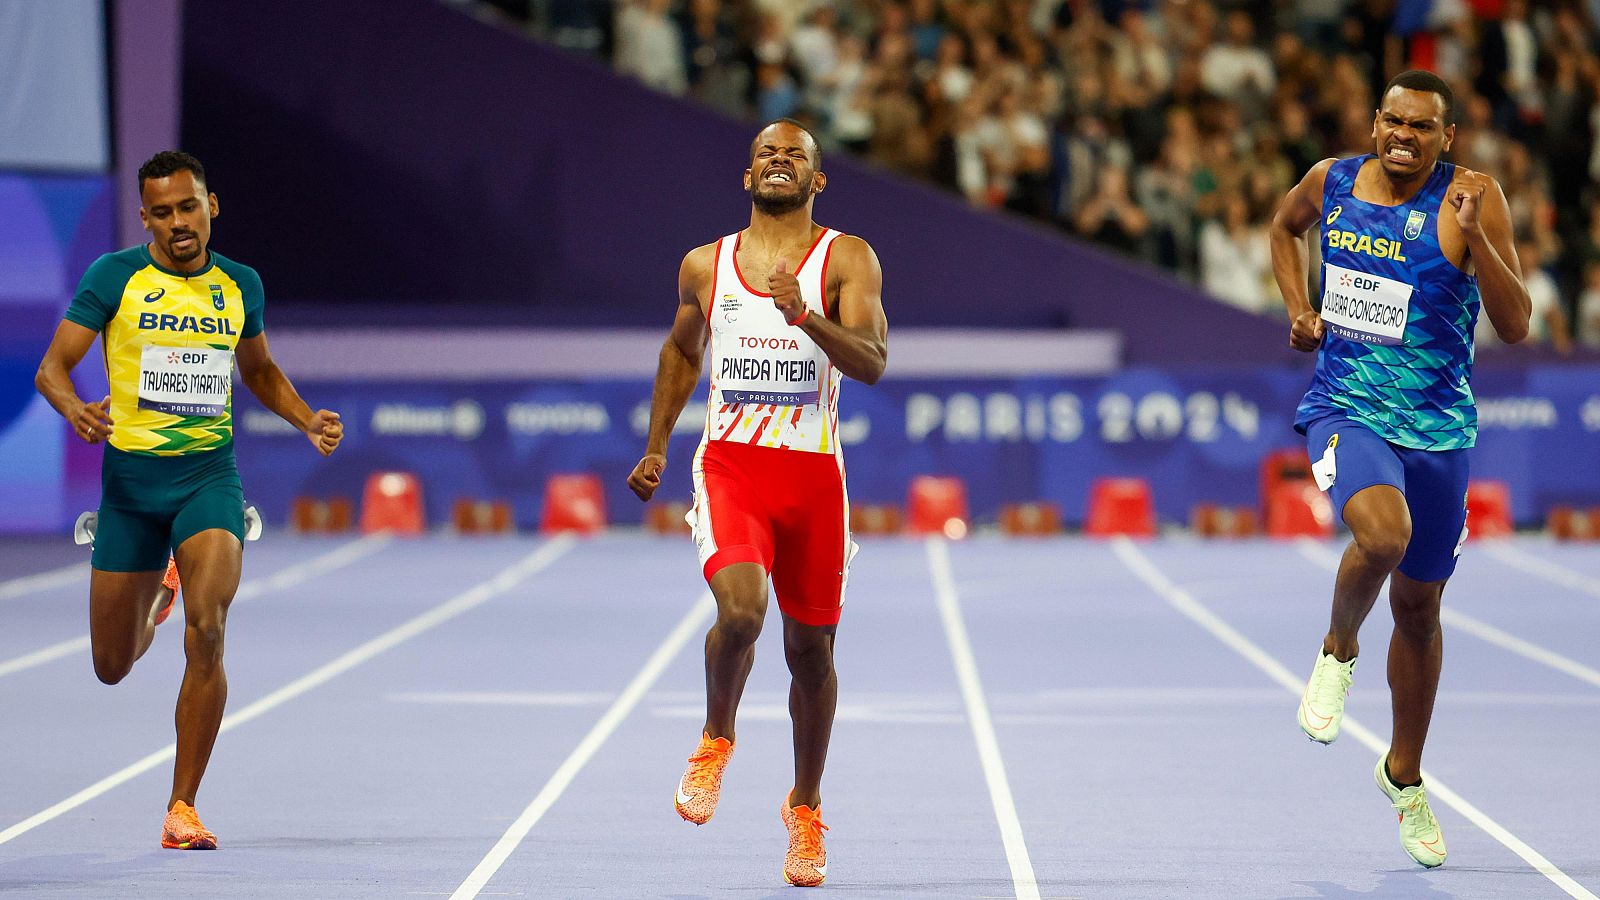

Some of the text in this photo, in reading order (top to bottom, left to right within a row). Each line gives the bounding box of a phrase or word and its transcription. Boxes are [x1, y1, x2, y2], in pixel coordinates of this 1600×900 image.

[1327, 229, 1406, 262] BRASIL
[1353, 277, 1381, 292] eDF
[1348, 297, 1404, 328] CONCEICAO
[138, 312, 236, 336] BRASIL
[738, 336, 799, 351] TOYOTA
[1339, 329, 1382, 344] PARIS 2024
[182, 352, 208, 365] eDF
[721, 357, 816, 382] PINEDA MEJIA
[143, 370, 229, 395] TAVARES MARTINS
[750, 394, 800, 403] PARIS 2024
[196, 406, 217, 414] 2024
[904, 391, 1260, 444] PARIS 2024
